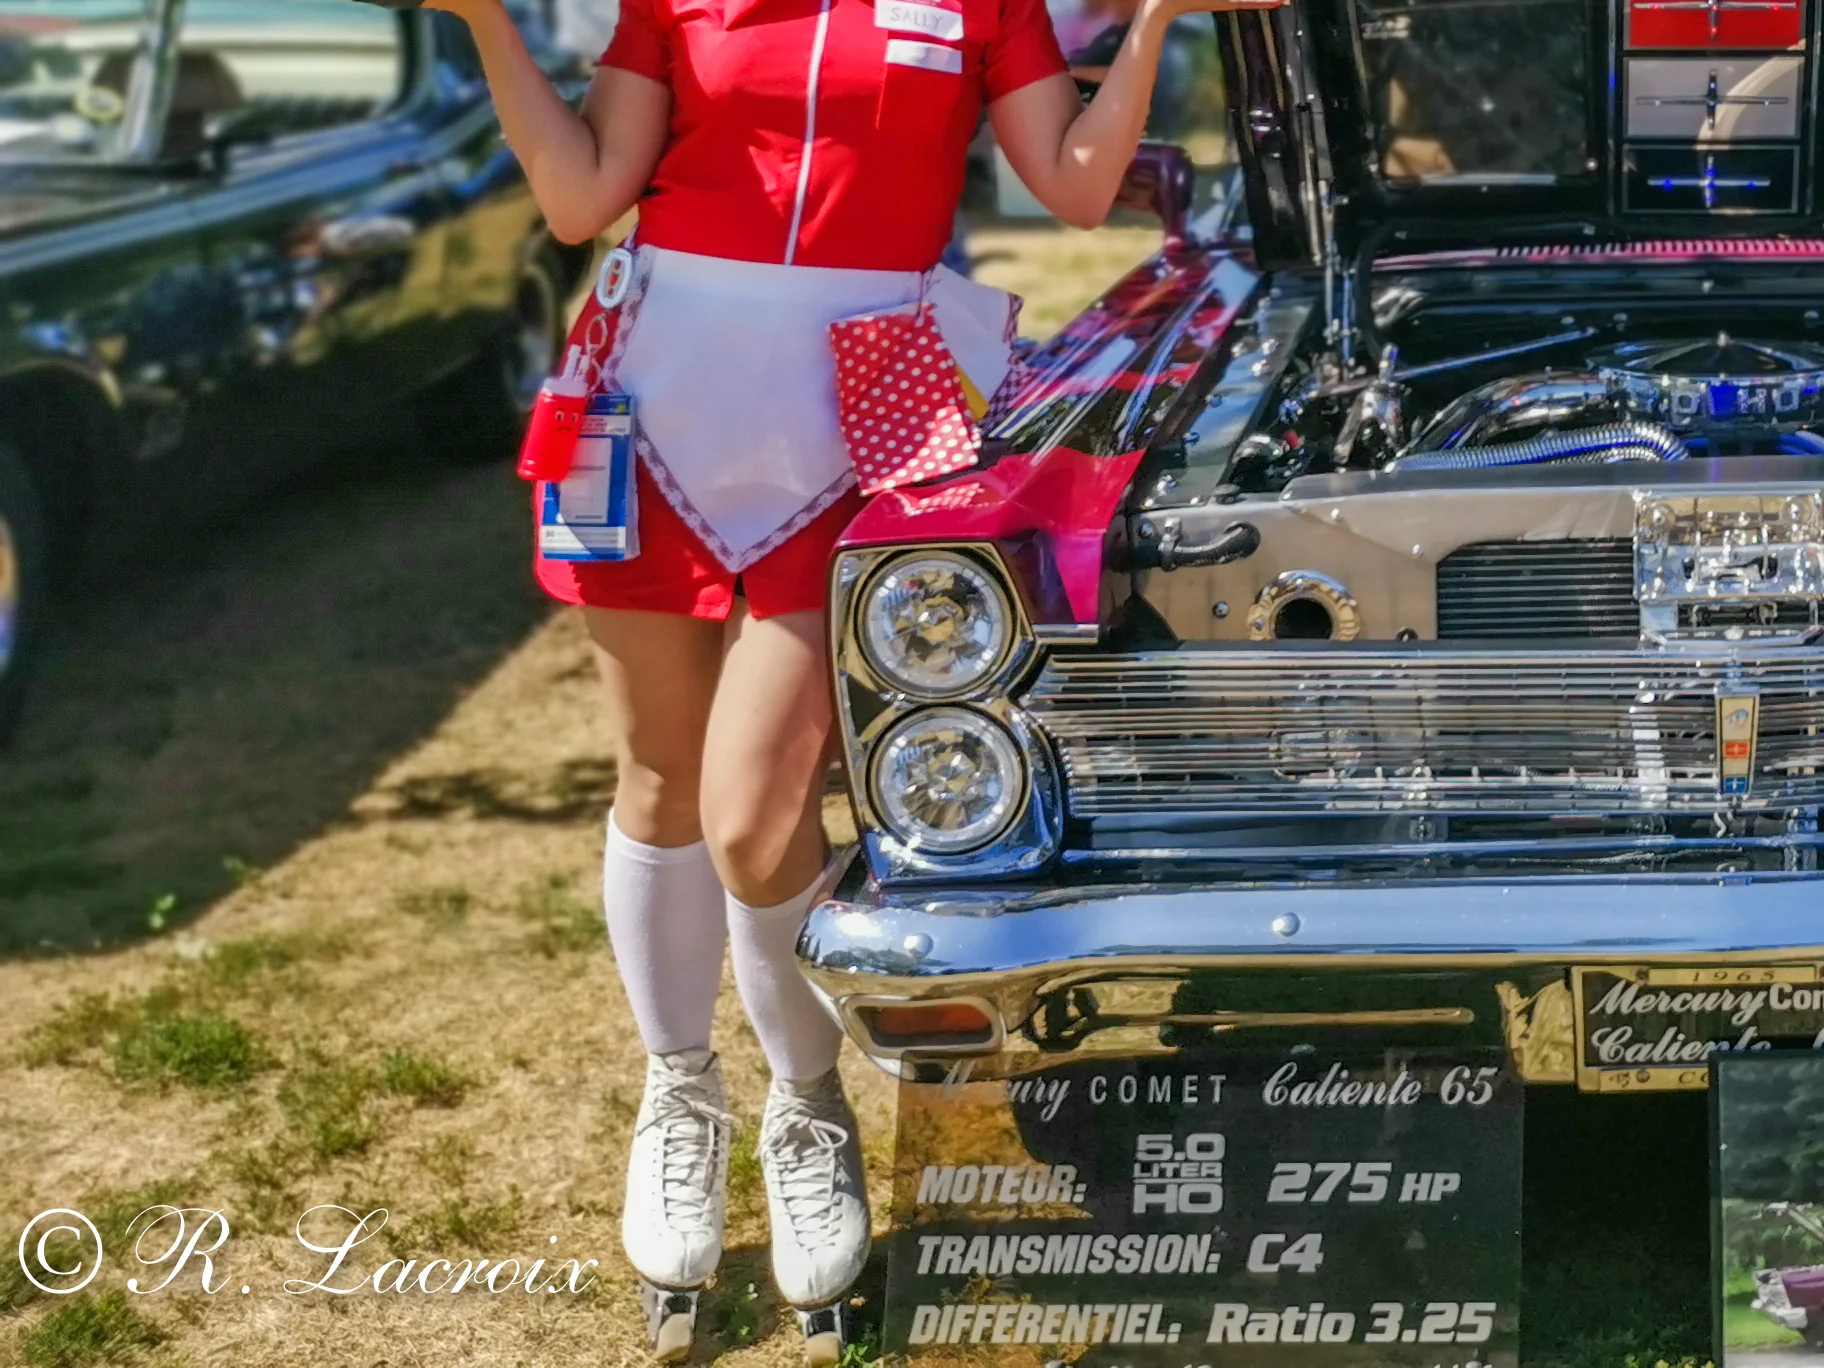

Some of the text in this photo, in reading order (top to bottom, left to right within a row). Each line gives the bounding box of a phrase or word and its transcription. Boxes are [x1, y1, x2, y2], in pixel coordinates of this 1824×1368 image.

[1691, 969, 1776, 983] 1965
[1589, 979, 1764, 1026] Mercury
[1089, 1074, 1227, 1104] COMET
[1262, 1061, 1423, 1109] Caliente
[1440, 1066, 1498, 1105] 65
[1135, 1133, 1226, 1162] 5.0
[916, 1164, 1087, 1204] MOTEUR:
[1133, 1162, 1223, 1179] LITER
[1267, 1162, 1462, 1203] 275 HP
[1133, 1183, 1224, 1214] HO
[917, 1233, 1325, 1275] TRANSMISSION: C4
[908, 1301, 1498, 1344] DIFFERENTIEL: Ratio 3.25
